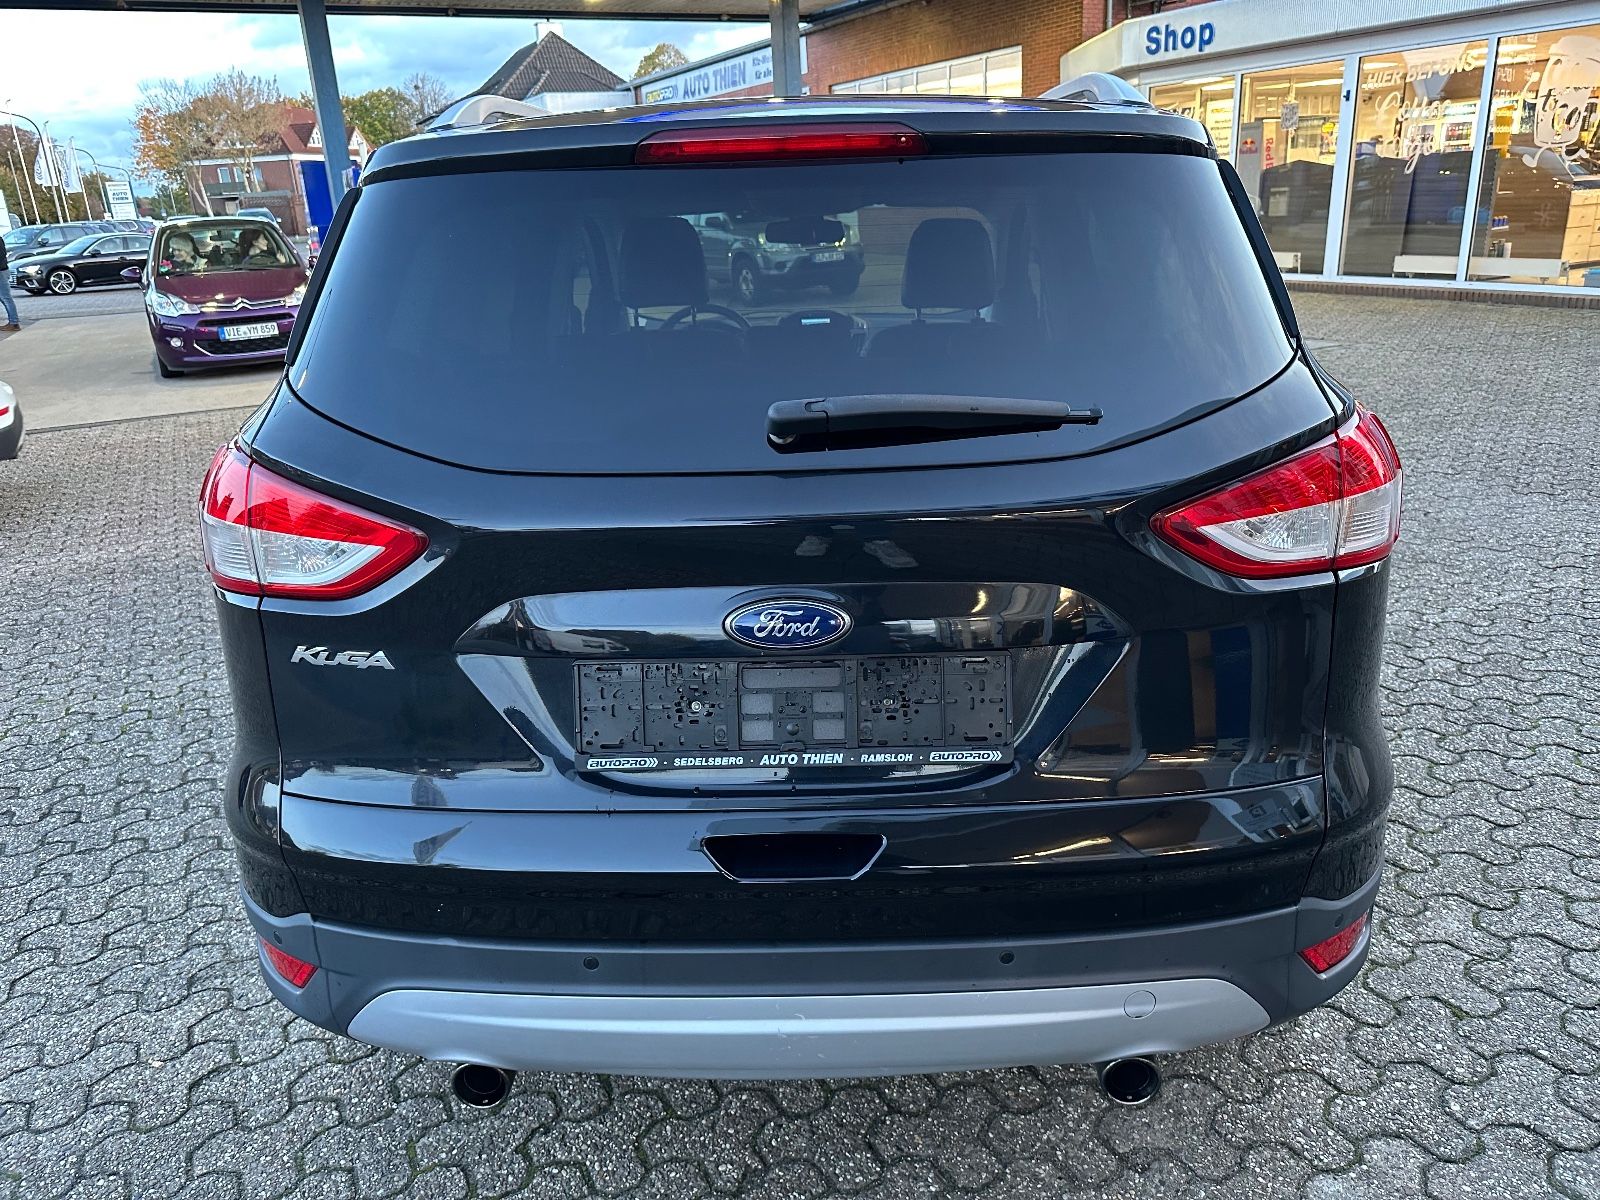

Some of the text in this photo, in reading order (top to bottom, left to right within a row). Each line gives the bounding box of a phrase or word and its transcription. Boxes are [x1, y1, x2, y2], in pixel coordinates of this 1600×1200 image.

[1146, 22, 1214, 55] Shop
[683, 73, 710, 99] AUTO
[712, 60, 747, 92] THIEN
[1367, 70, 1402, 86] HIER
[1265, 137, 1274, 160] Red
[225, 323, 277, 338] VIE YM 859
[753, 609, 821, 638] Ford
[290, 645, 396, 670] KUGA
[673, 756, 744, 767] SEDELSBERG
[759, 753, 799, 766] AUTO
[801, 752, 844, 765] THIEN
[860, 753, 914, 763] RAMSLOH
